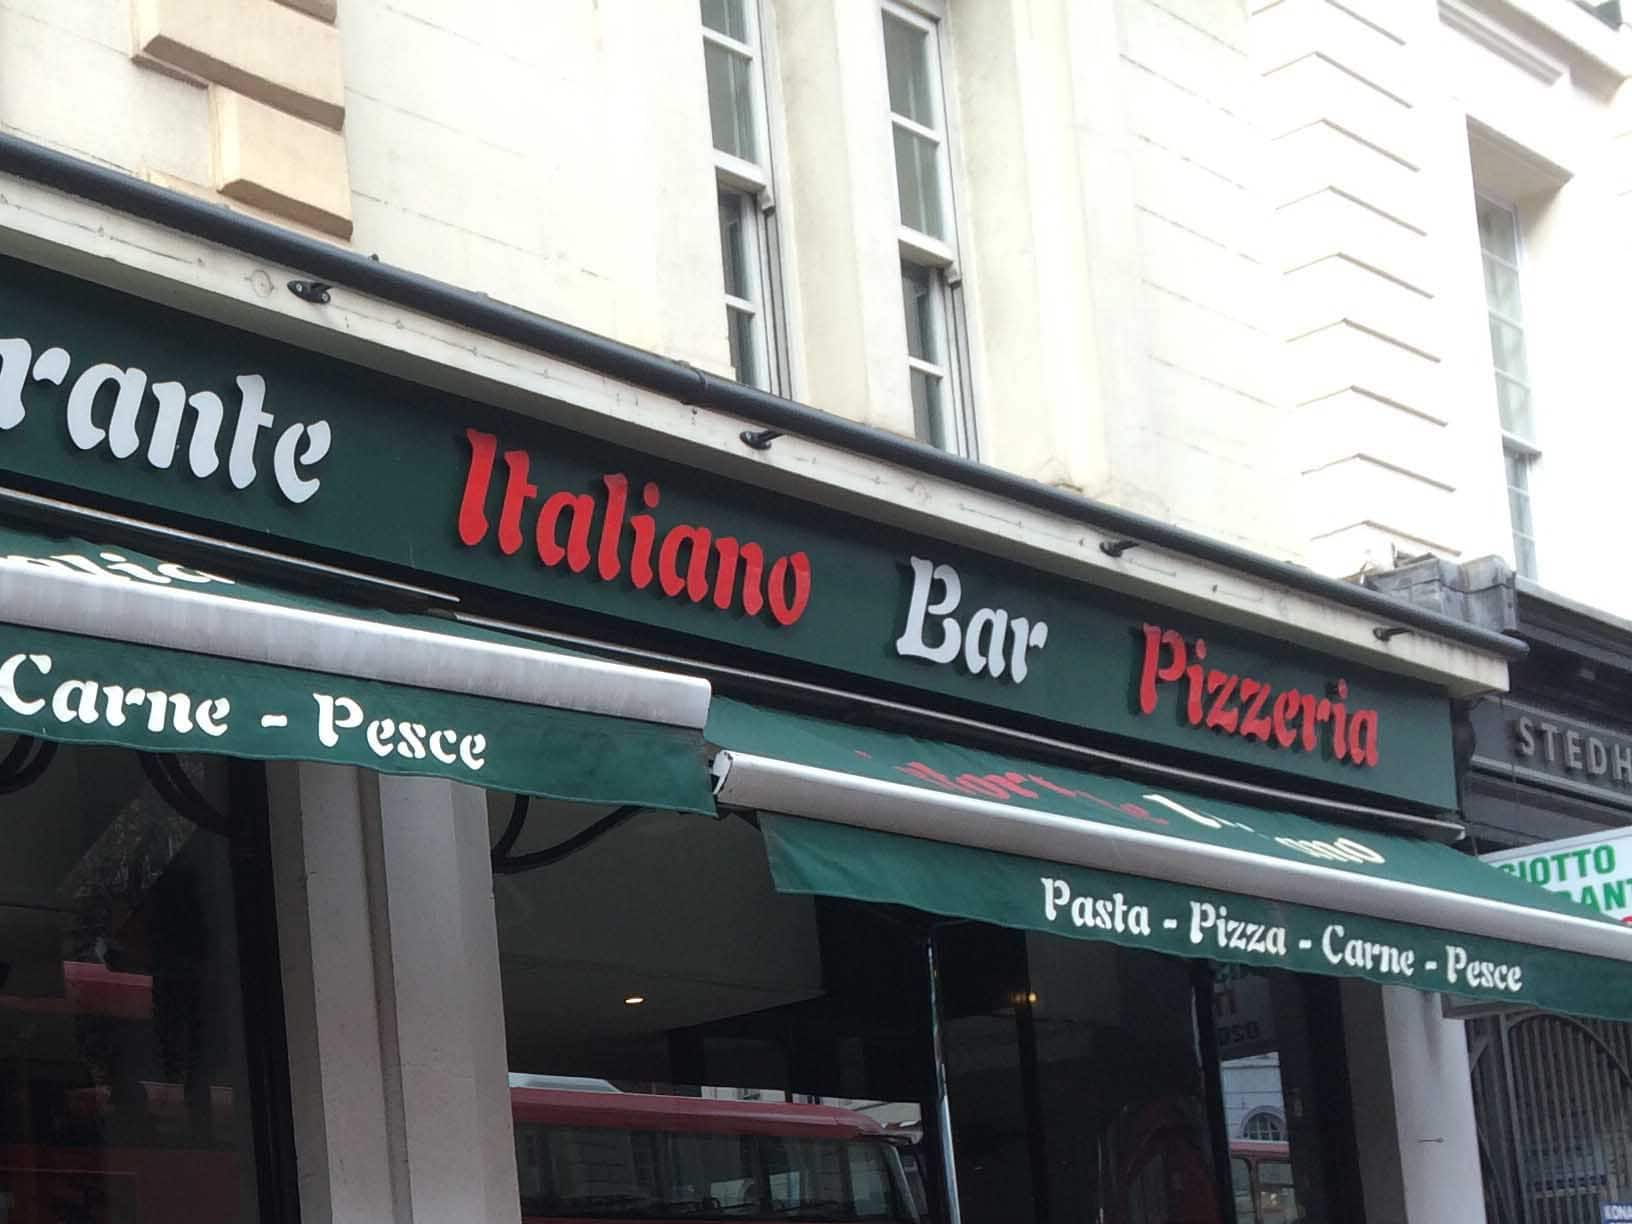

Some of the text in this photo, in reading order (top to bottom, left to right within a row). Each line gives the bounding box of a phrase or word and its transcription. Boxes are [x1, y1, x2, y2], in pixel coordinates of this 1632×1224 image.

[457, 430, 811, 626] Italiano
[896, 555, 1048, 686] Bar
[1139, 622, 1379, 767] Pizzeria
[311, 692, 488, 771] Pesce
[1519, 716, 1632, 784] STEDH
[1039, 876, 1152, 937] Pasta
[1188, 900, 1288, 957] Pizza
[1320, 923, 1416, 978] Carne
[1444, 944, 1524, 993] Pesce
